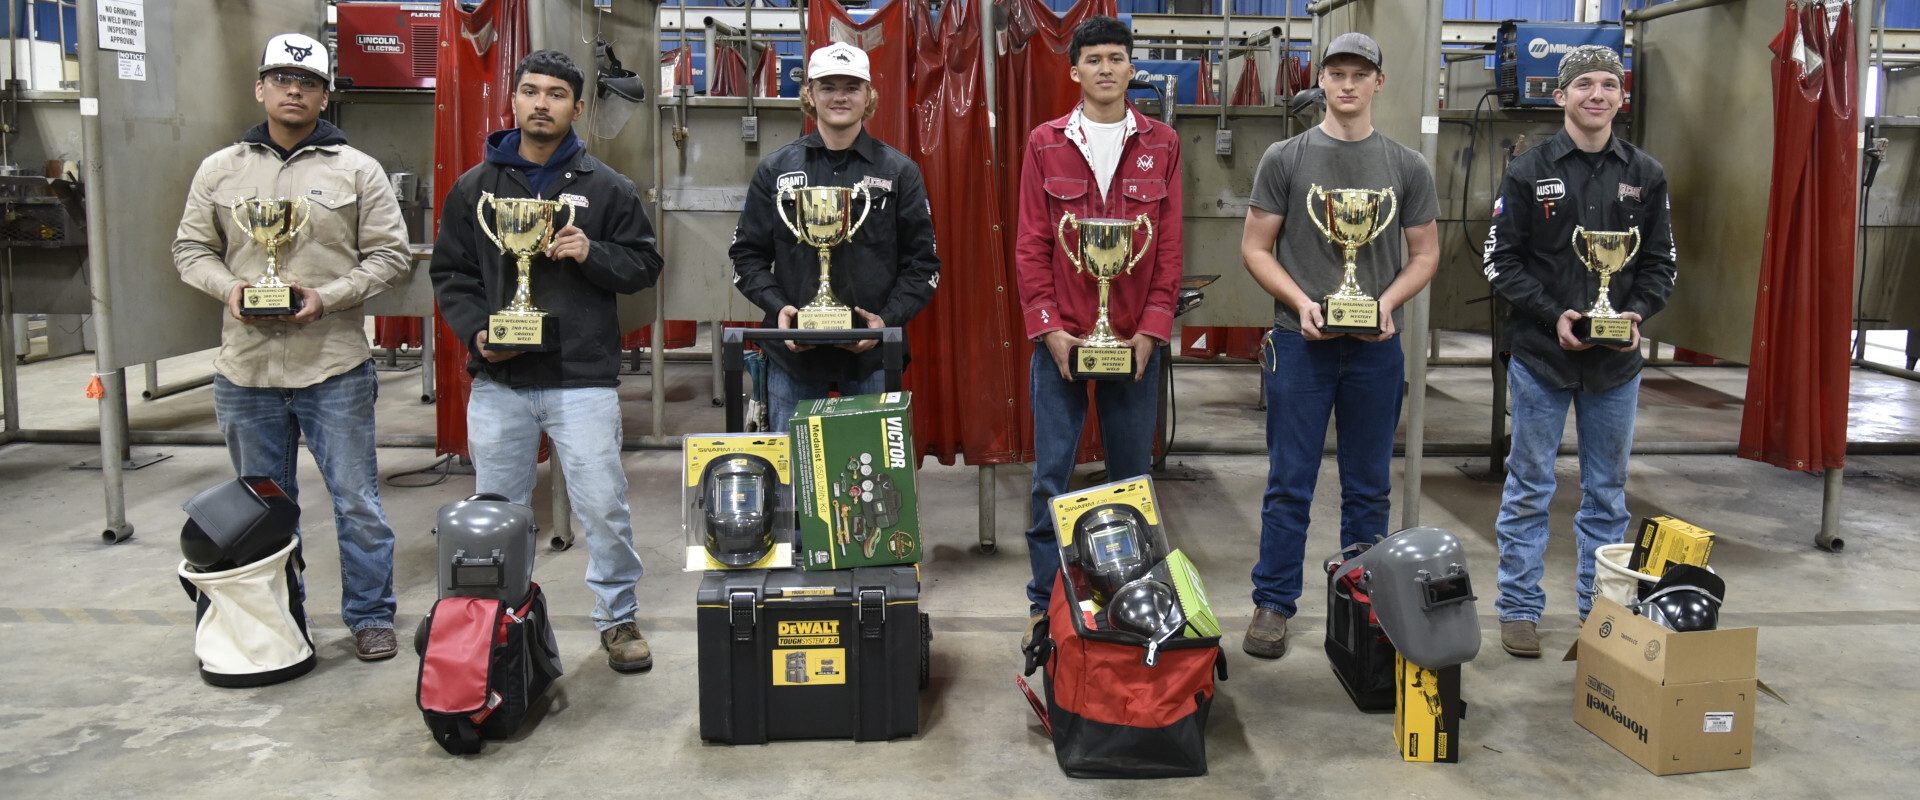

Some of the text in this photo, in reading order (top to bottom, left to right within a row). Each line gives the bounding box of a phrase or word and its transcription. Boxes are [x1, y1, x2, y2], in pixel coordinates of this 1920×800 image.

[113, 7, 137, 17] GRINDING
[99, 14, 143, 28] ON WELD WITHOUT
[107, 26, 137, 36] INSPECTORS
[110, 36, 135, 45] APPROVAL
[358, 36, 396, 45] LINCOLN
[120, 52, 144, 61] NOTICE
[1129, 185, 1138, 193] FR
[1536, 183, 1563, 196] AUSTIN
[812, 424, 823, 462] Medalist
[886, 416, 906, 469] VICTOR
[1064, 501, 1096, 513] SWARM
[1586, 692, 1648, 744] Honeywell
